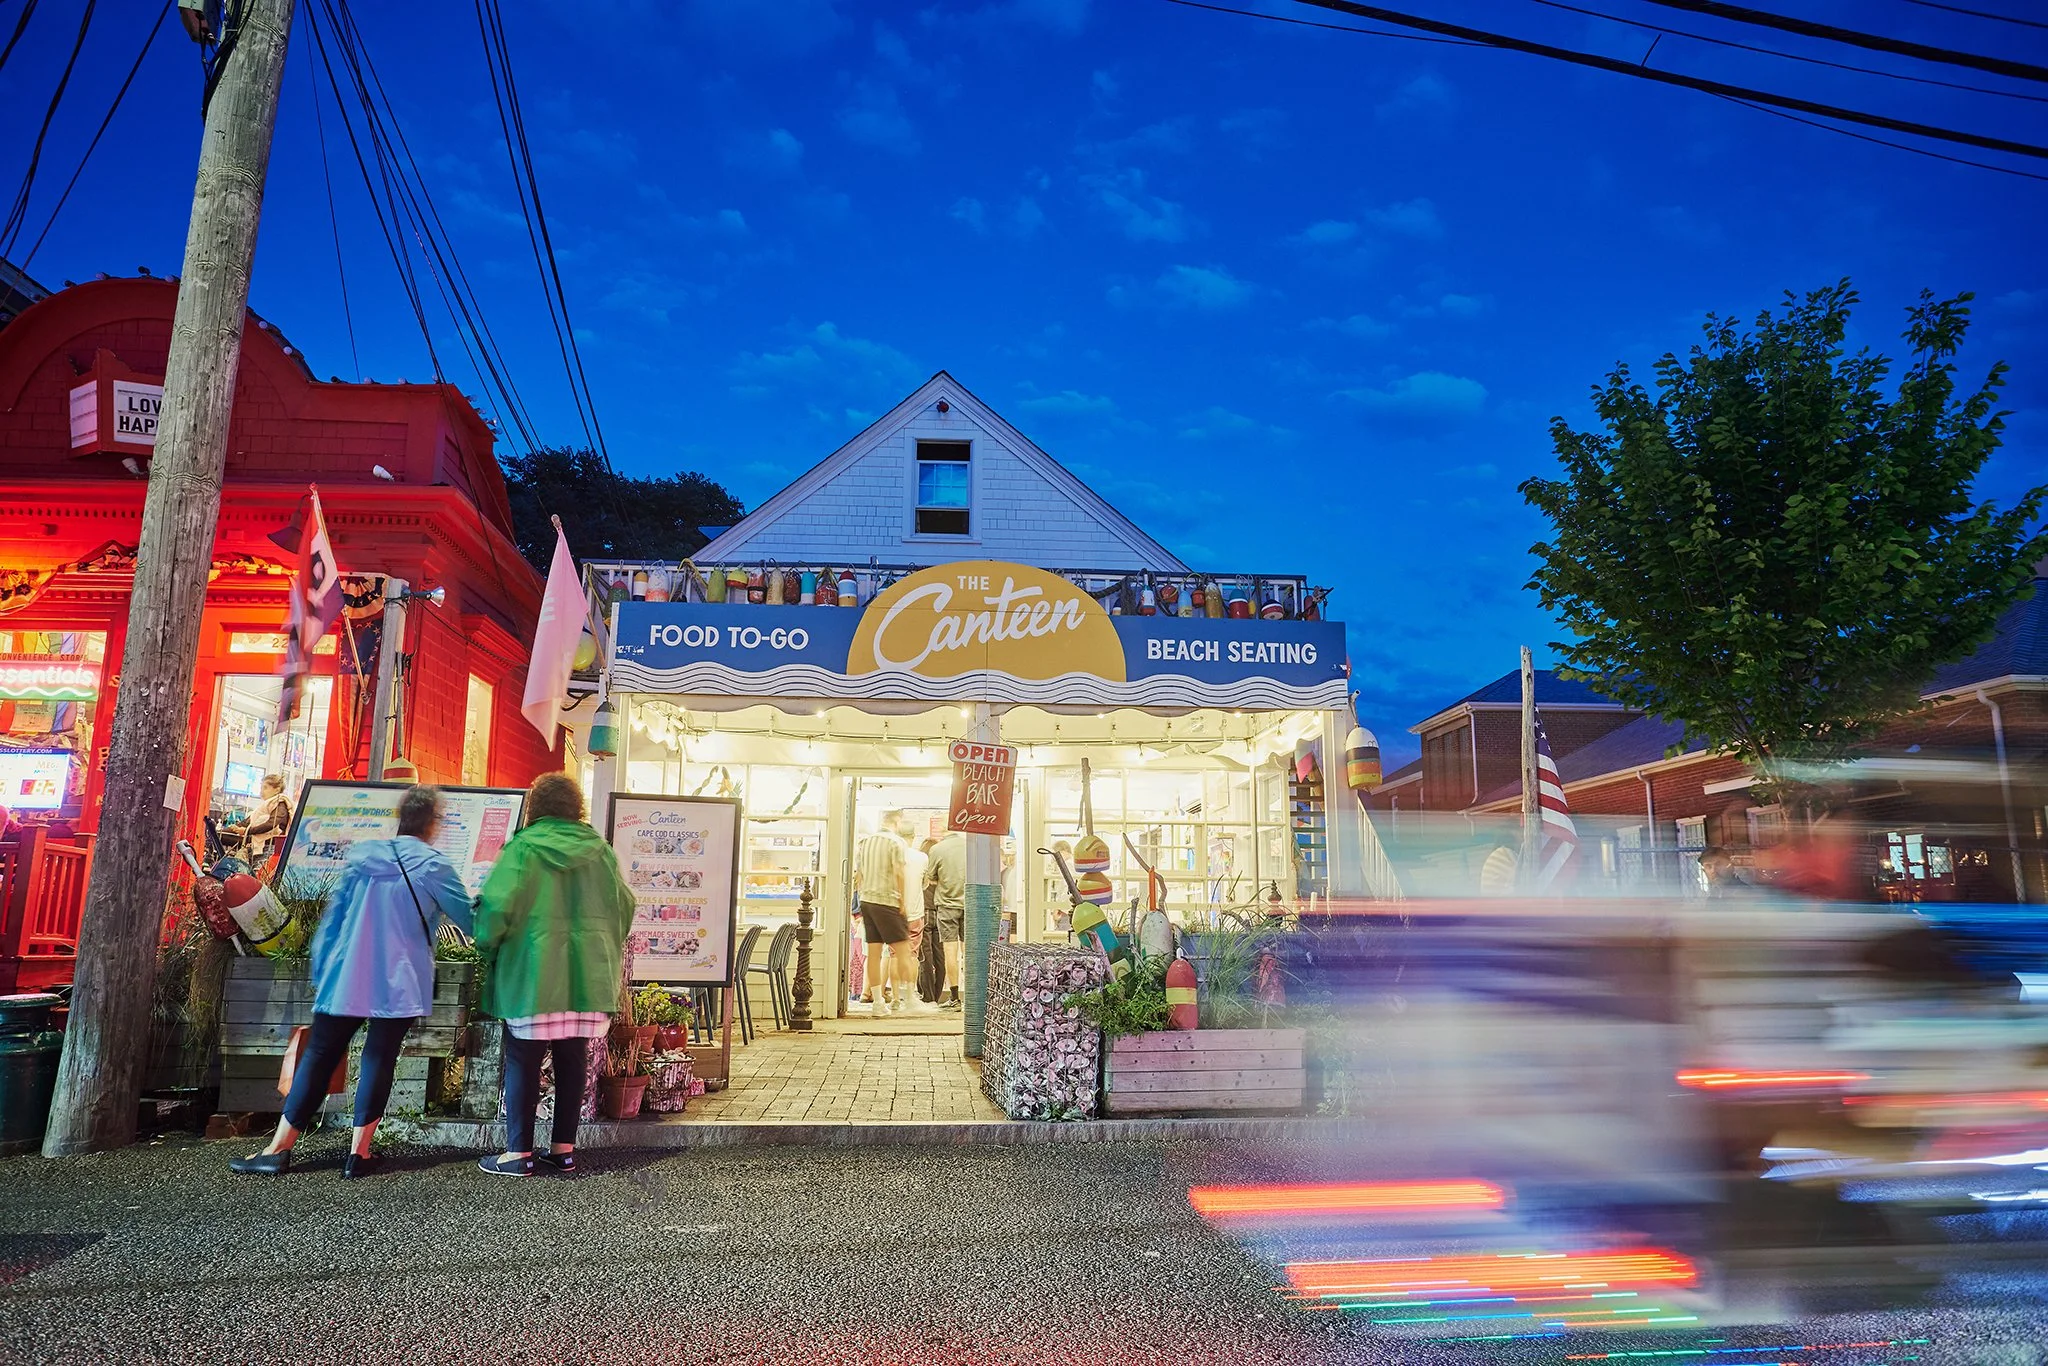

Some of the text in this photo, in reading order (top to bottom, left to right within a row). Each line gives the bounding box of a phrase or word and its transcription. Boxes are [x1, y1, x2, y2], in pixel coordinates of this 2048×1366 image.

[957, 575, 990, 591] THE
[873, 576, 1086, 671] Canteen
[650, 624, 809, 650] FOOD TO-GO
[1147, 639, 1317, 665] BEACH SEATING
[953, 743, 1009, 764] OPEN
[962, 763, 1005, 782] BEACH
[966, 782, 1001, 806] BAR
[649, 811, 687, 825] Canteen
[955, 808, 997, 830] Open
[637, 829, 699, 839] CAPE COD CLASSICS
[666, 931, 695, 939] SWEETS
